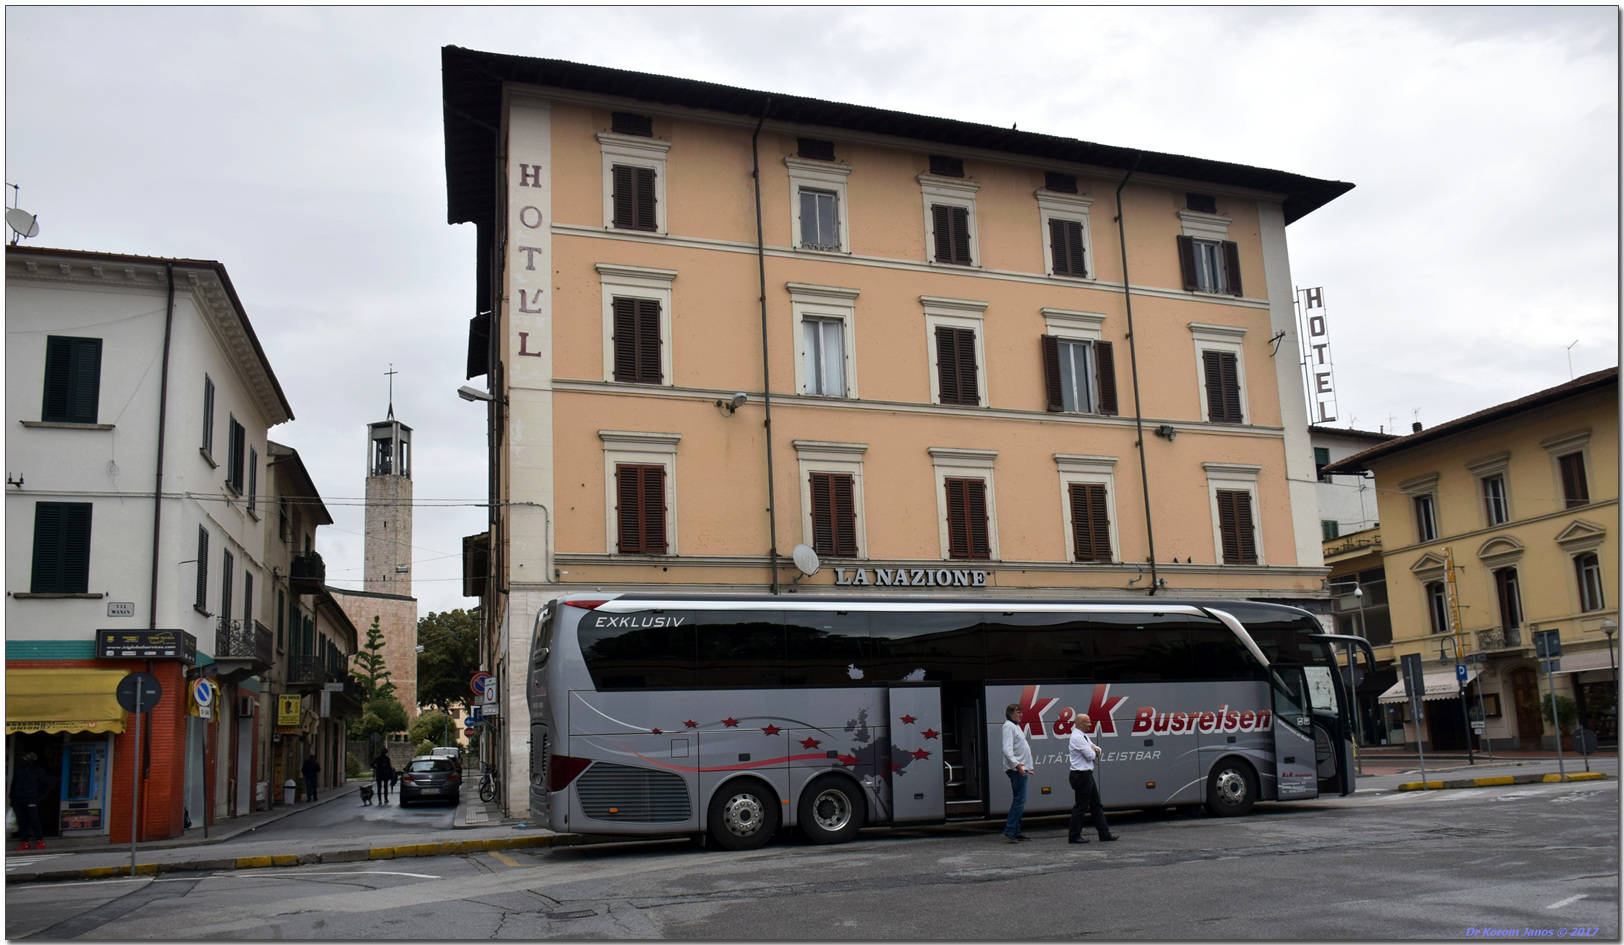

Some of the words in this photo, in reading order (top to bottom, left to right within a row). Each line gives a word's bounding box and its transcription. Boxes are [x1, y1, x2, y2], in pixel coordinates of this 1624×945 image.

[1306, 288, 1336, 422] HOTEL
[835, 567, 870, 585] LA
[875, 568, 987, 586] NAZIONE
[595, 616, 685, 628] EXKLUSIV
[1131, 705, 1272, 737] Busreisen
[1035, 752, 1070, 765] LITÄT
[1100, 750, 1161, 762] LEISTBAR
